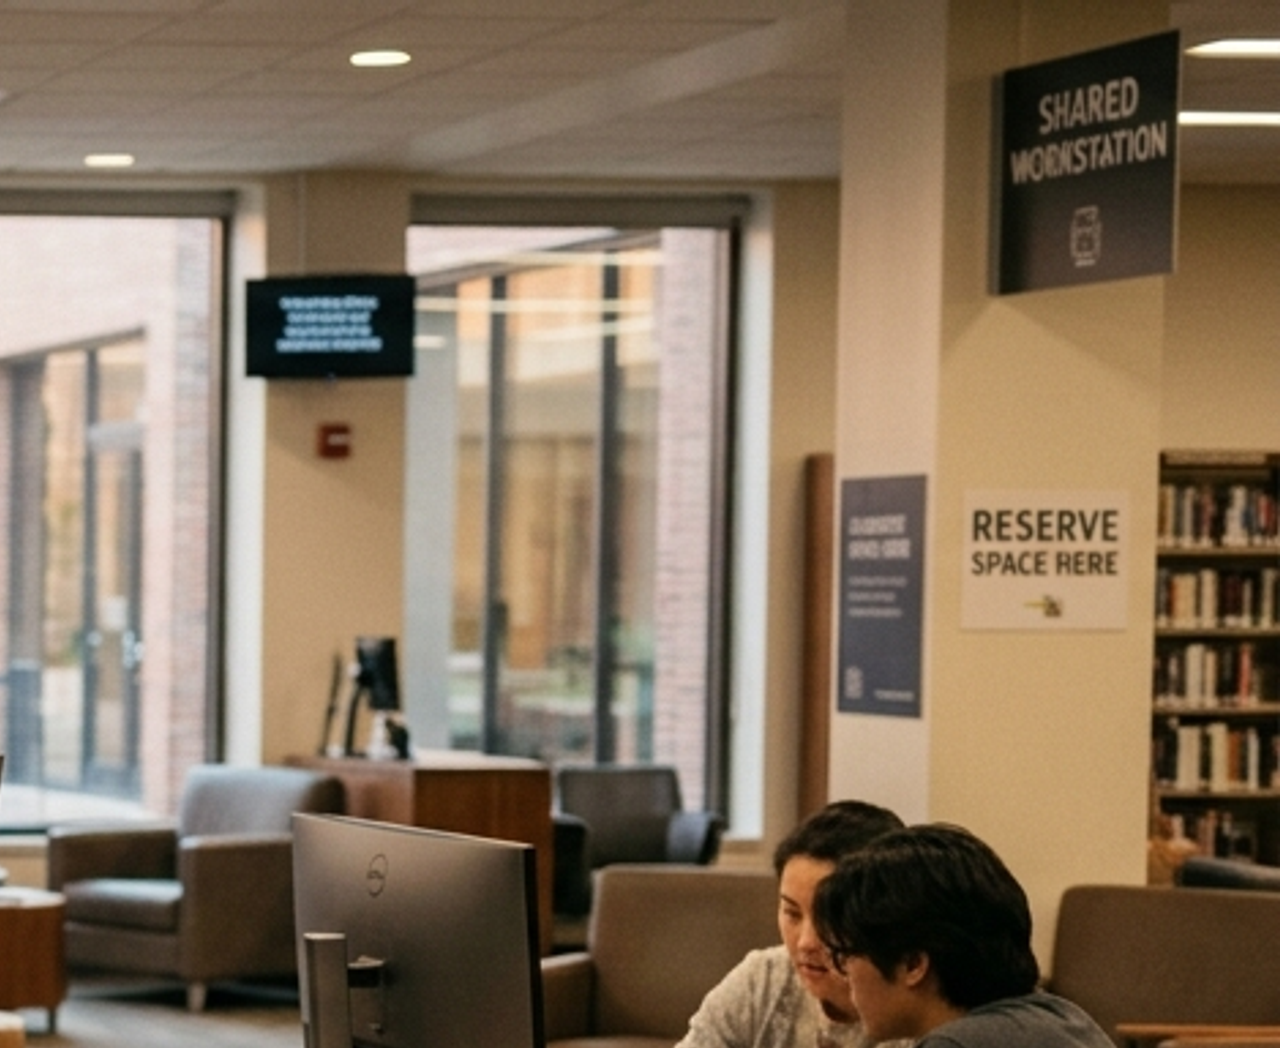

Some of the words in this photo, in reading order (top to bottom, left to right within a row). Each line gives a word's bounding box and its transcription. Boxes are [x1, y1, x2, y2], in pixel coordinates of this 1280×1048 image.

[1038, 76, 1139, 135] SHARED
[972, 509, 1119, 542] RESERVE
[971, 550, 1048, 576] SPACE
[1055, 550, 1119, 576] HERE
